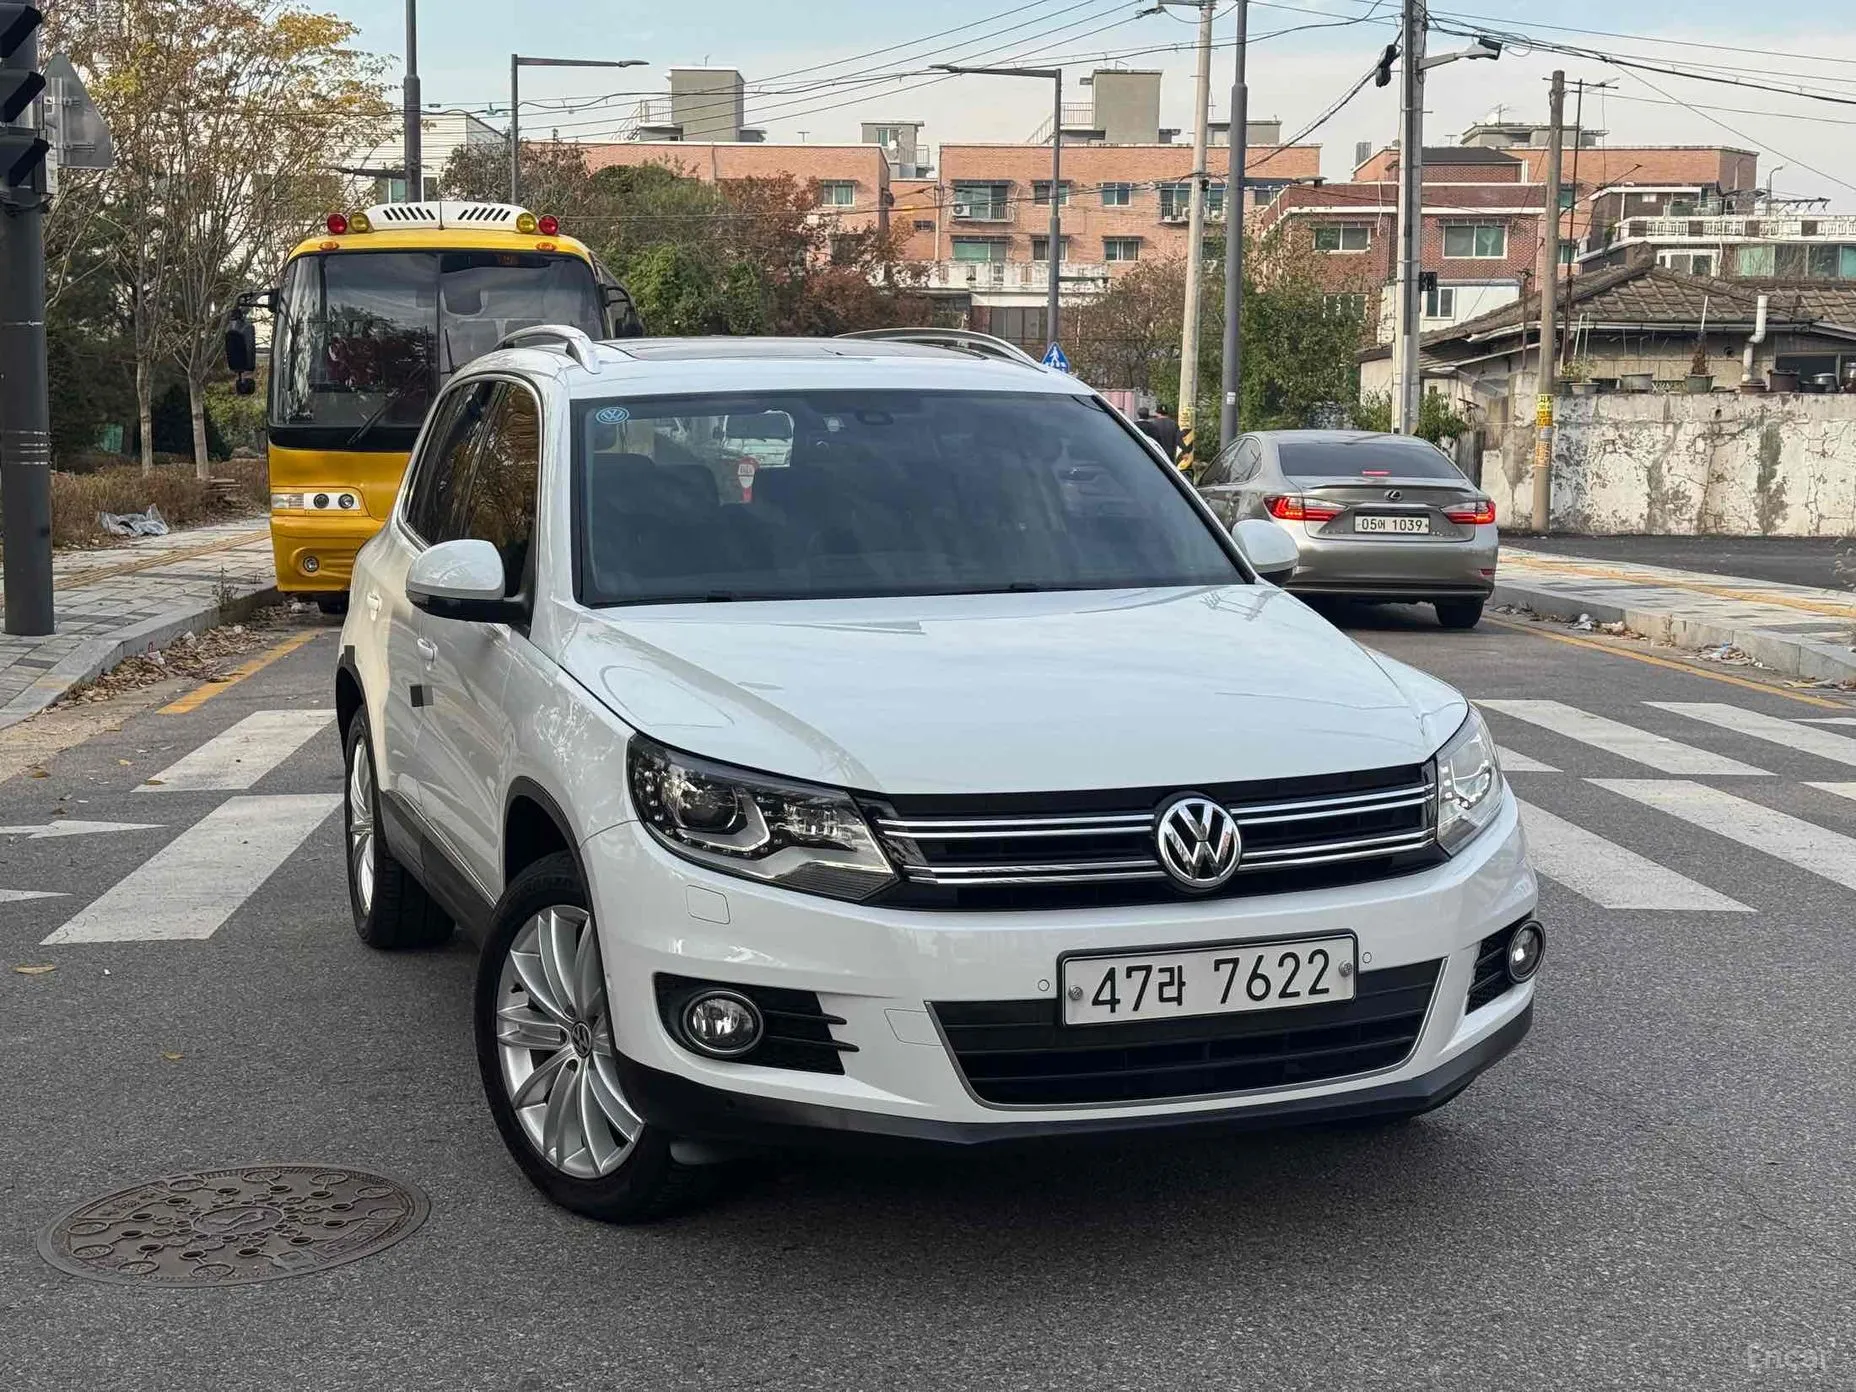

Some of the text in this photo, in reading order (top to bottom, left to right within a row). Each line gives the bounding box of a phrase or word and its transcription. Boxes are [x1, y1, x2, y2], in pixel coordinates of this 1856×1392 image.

[1392, 519, 1423, 531] 1039
[1160, 800, 1238, 883] VW
[1091, 948, 1330, 1013] 47라 7622
